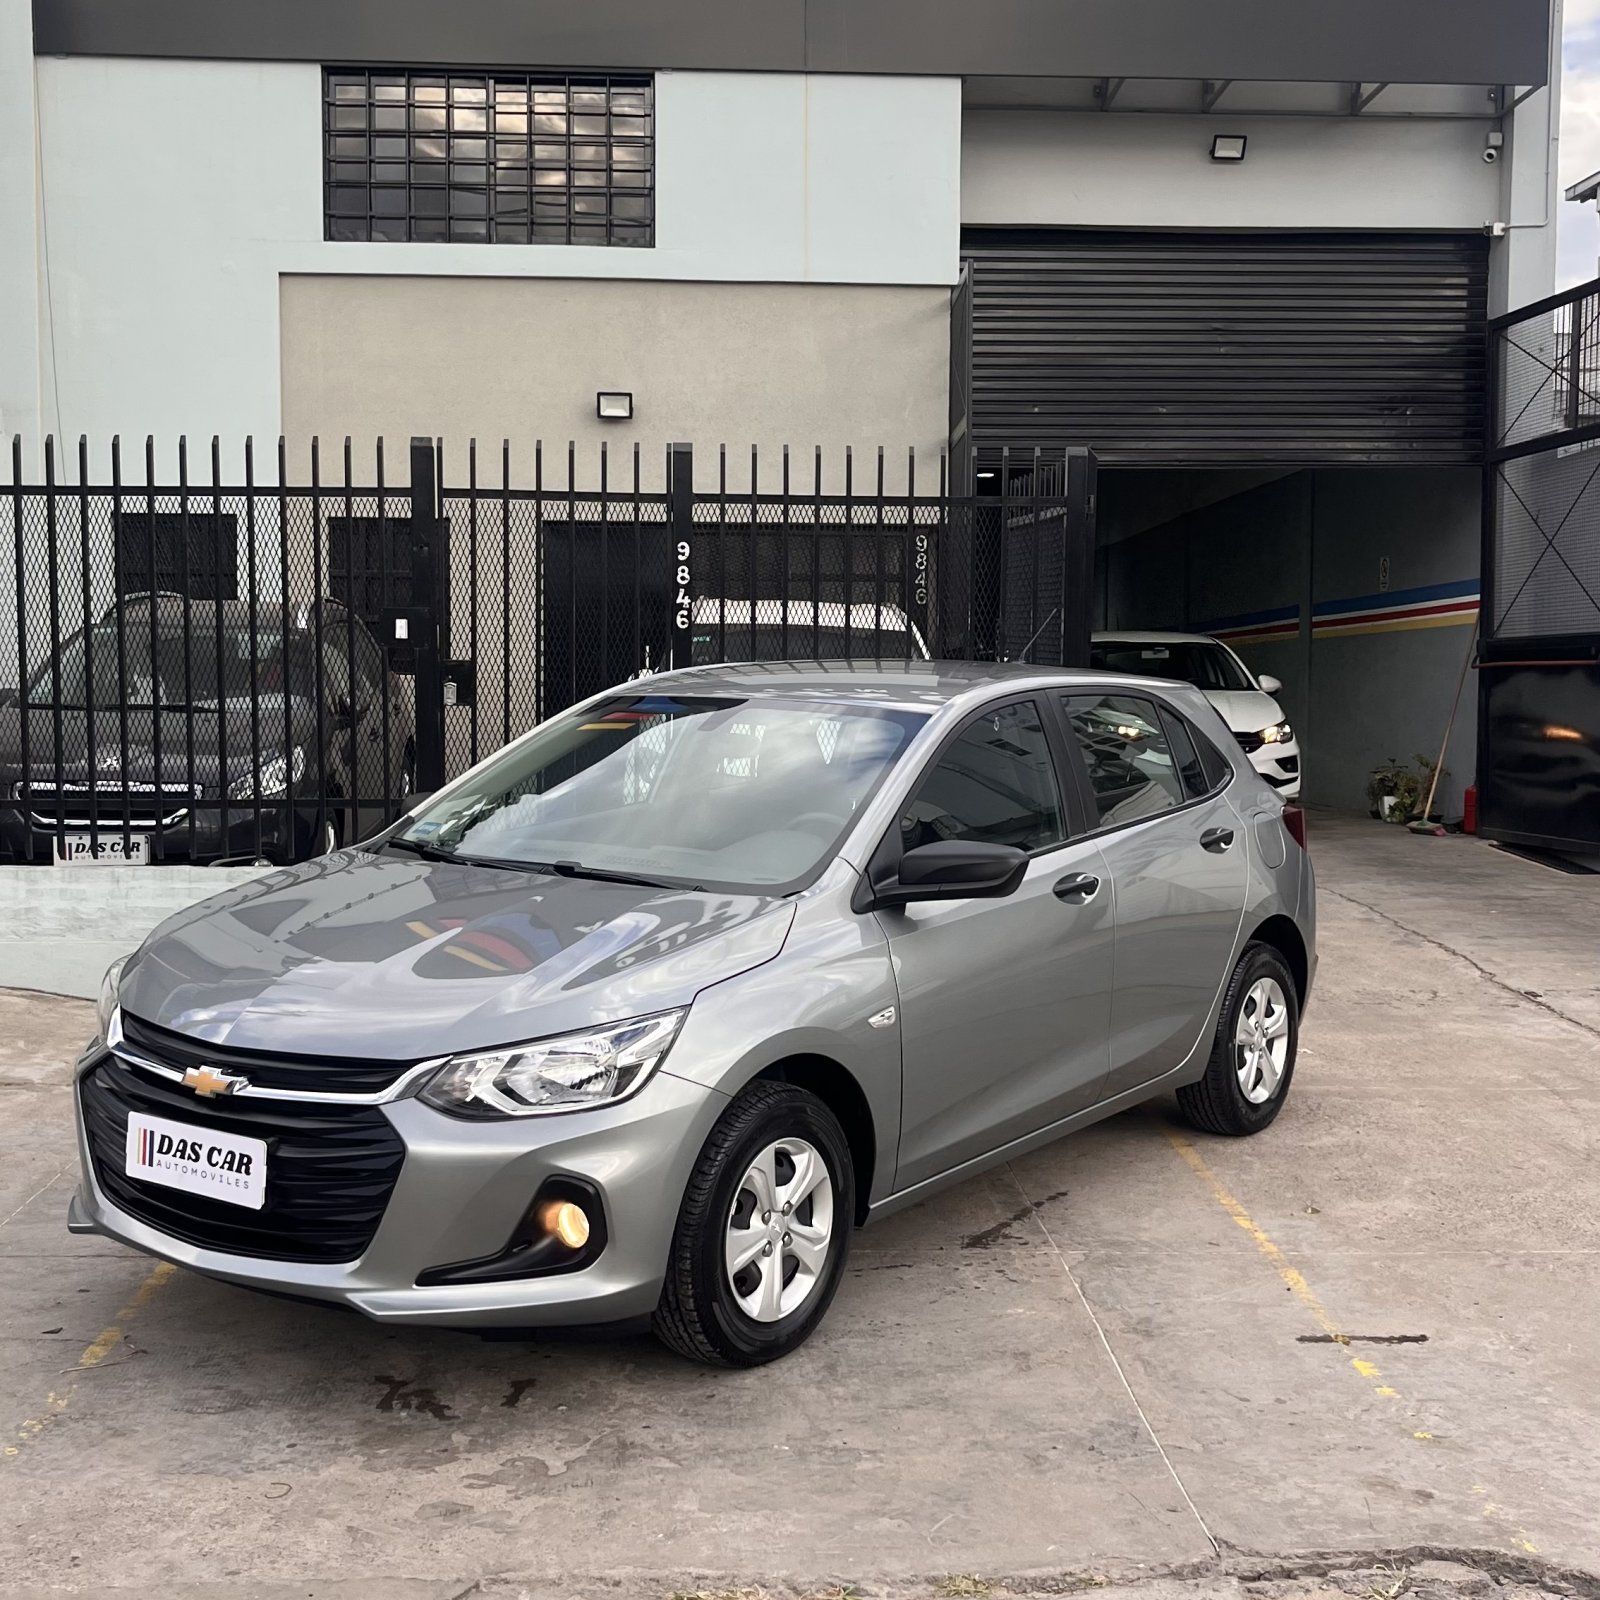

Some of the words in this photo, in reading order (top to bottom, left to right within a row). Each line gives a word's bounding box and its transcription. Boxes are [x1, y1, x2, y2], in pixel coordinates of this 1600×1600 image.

[676, 541, 691, 629] 9846
[915, 534, 928, 605] 9846
[156, 1159, 249, 1189] AUTOMOVILES
[157, 1134, 203, 1162] DAS
[206, 1146, 253, 1176] CAR
